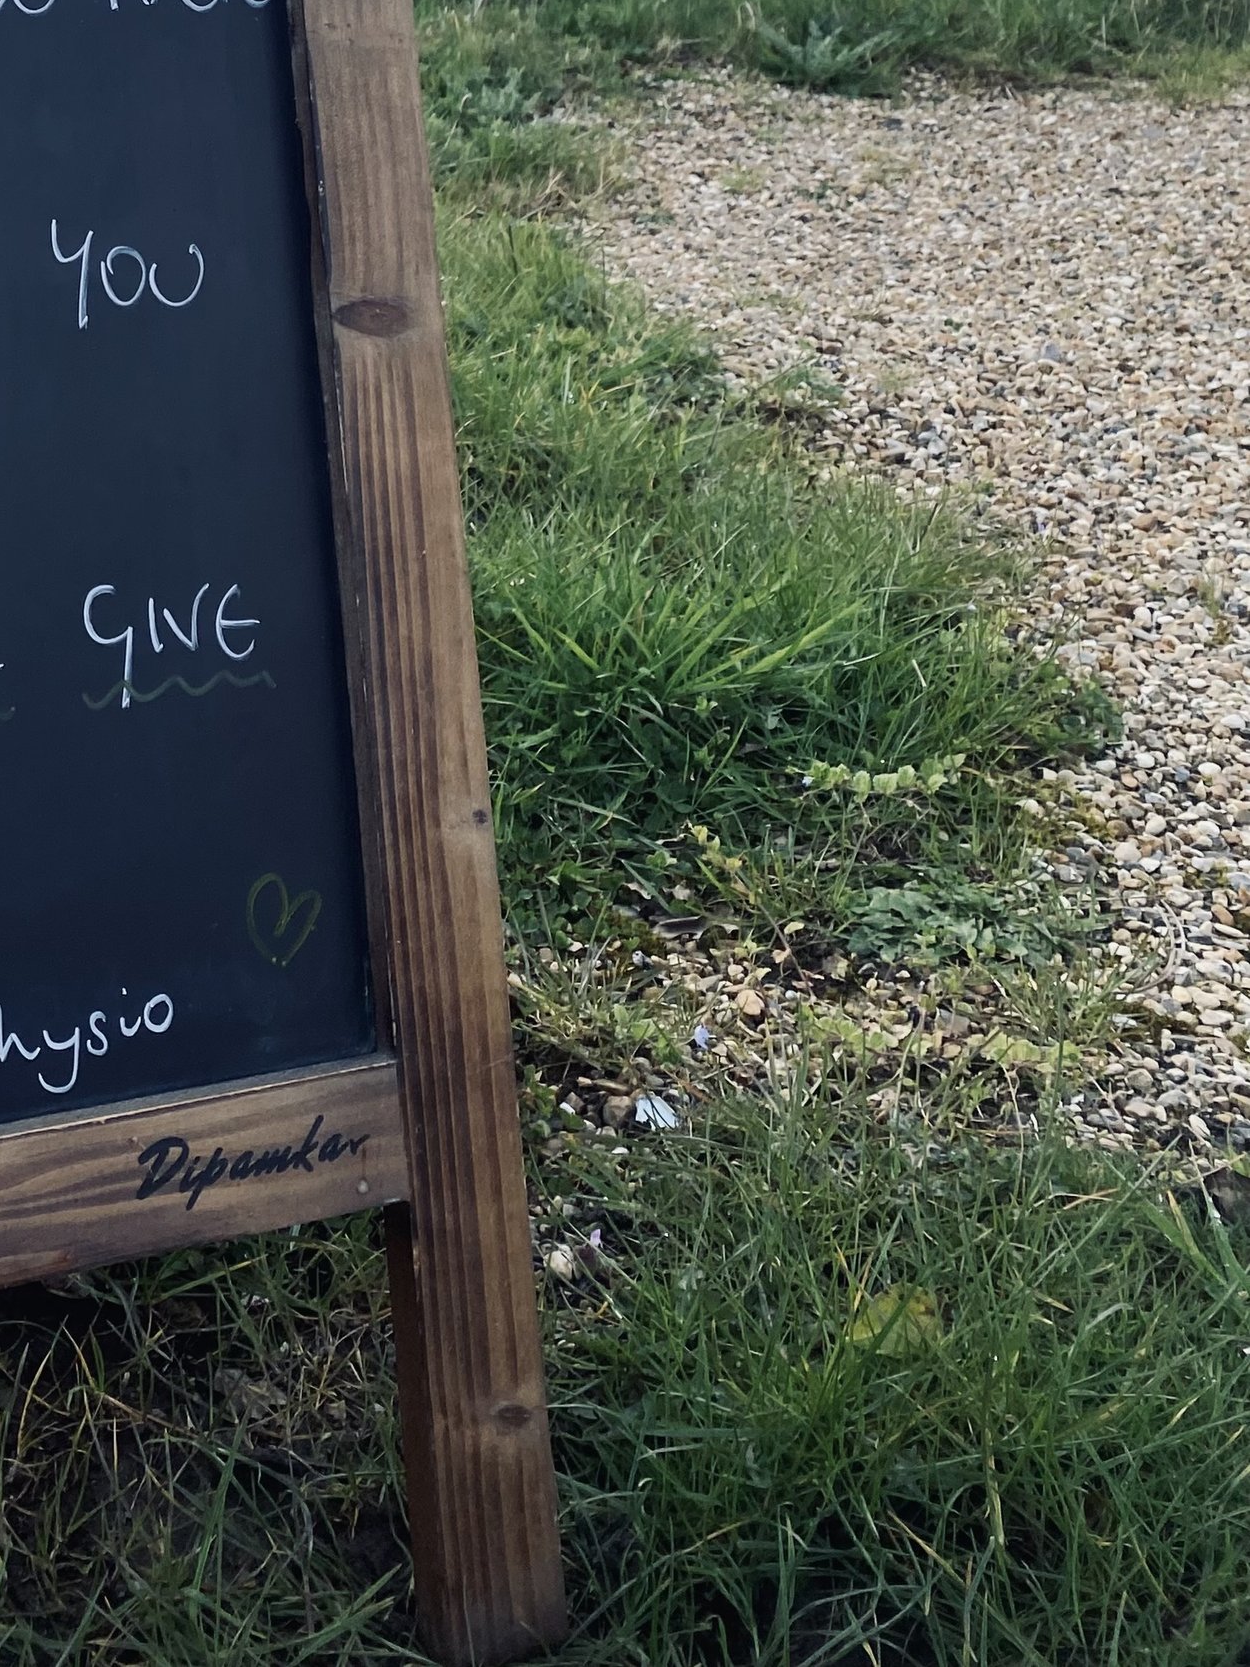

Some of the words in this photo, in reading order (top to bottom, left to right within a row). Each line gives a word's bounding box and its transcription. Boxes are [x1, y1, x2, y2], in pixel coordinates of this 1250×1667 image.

[50, 218, 205, 330] YOU
[83, 582, 261, 709] GIVE
[136, 1114, 371, 1211] Dipamkar
